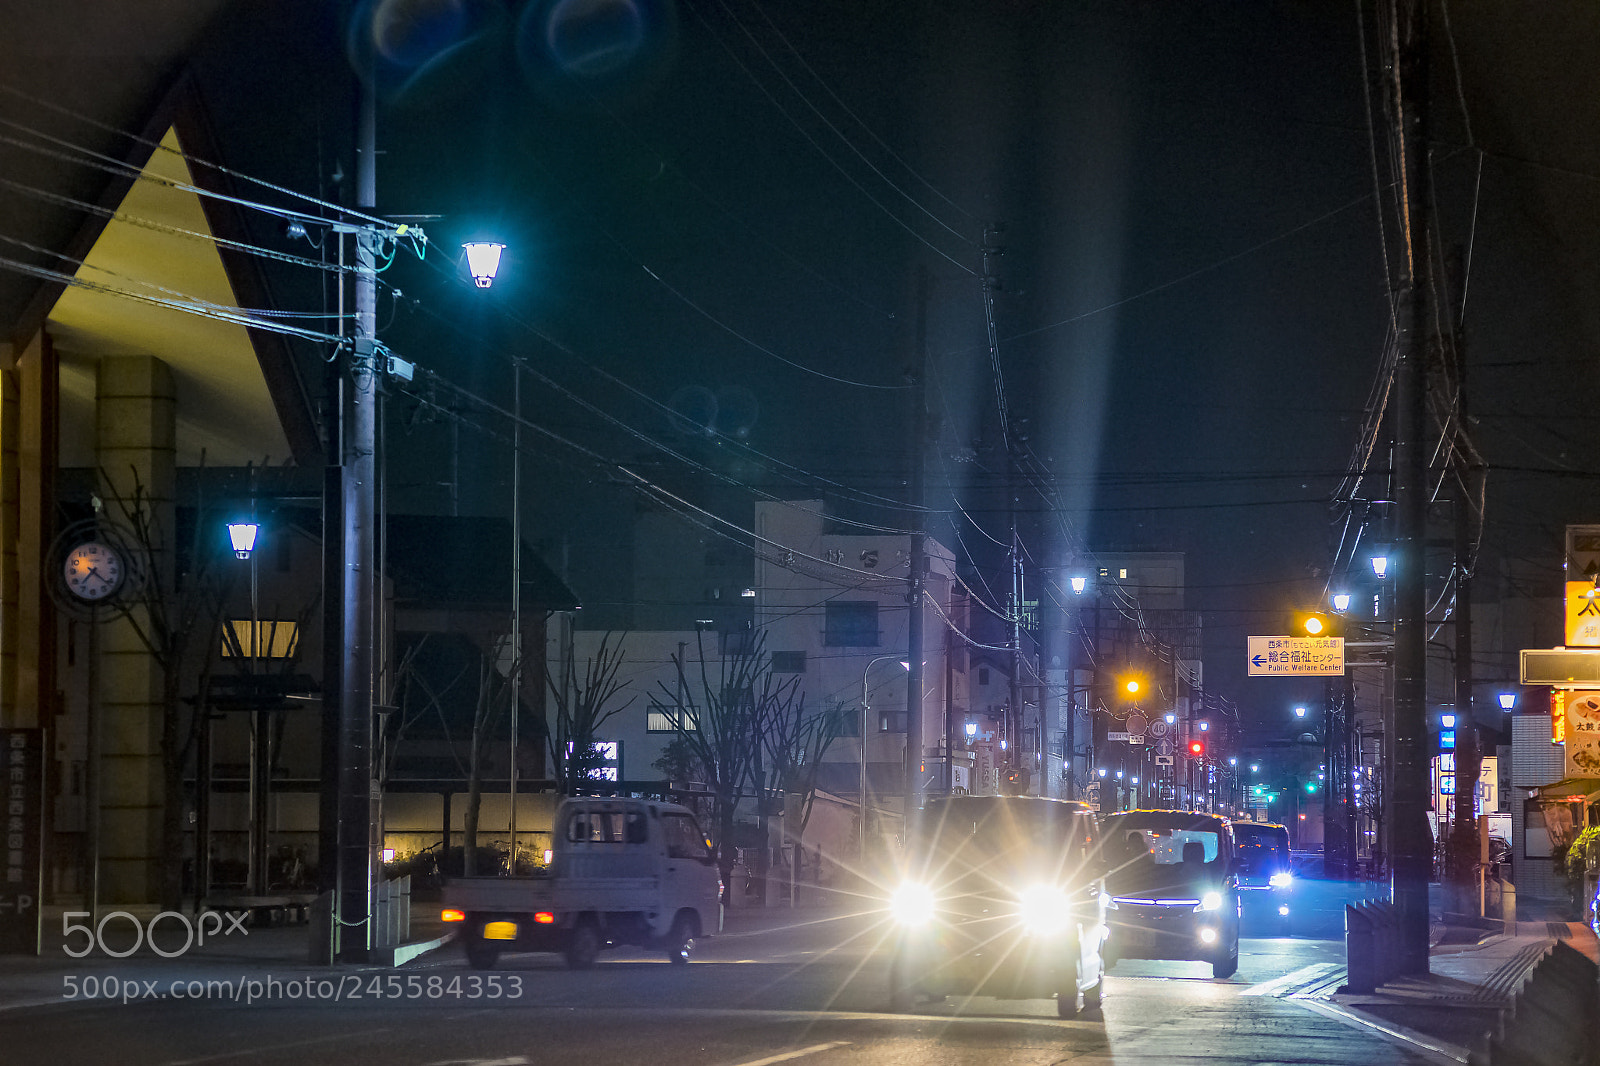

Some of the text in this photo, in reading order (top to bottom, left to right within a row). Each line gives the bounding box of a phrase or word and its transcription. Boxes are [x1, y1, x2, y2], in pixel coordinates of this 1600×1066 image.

[1268, 650, 1342, 663] 総合福祉センター
[1268, 664, 1289, 672] Public
[1319, 663, 1342, 671] Center
[1153, 723, 1165, 732] 40
[18, 894, 32, 914] P
